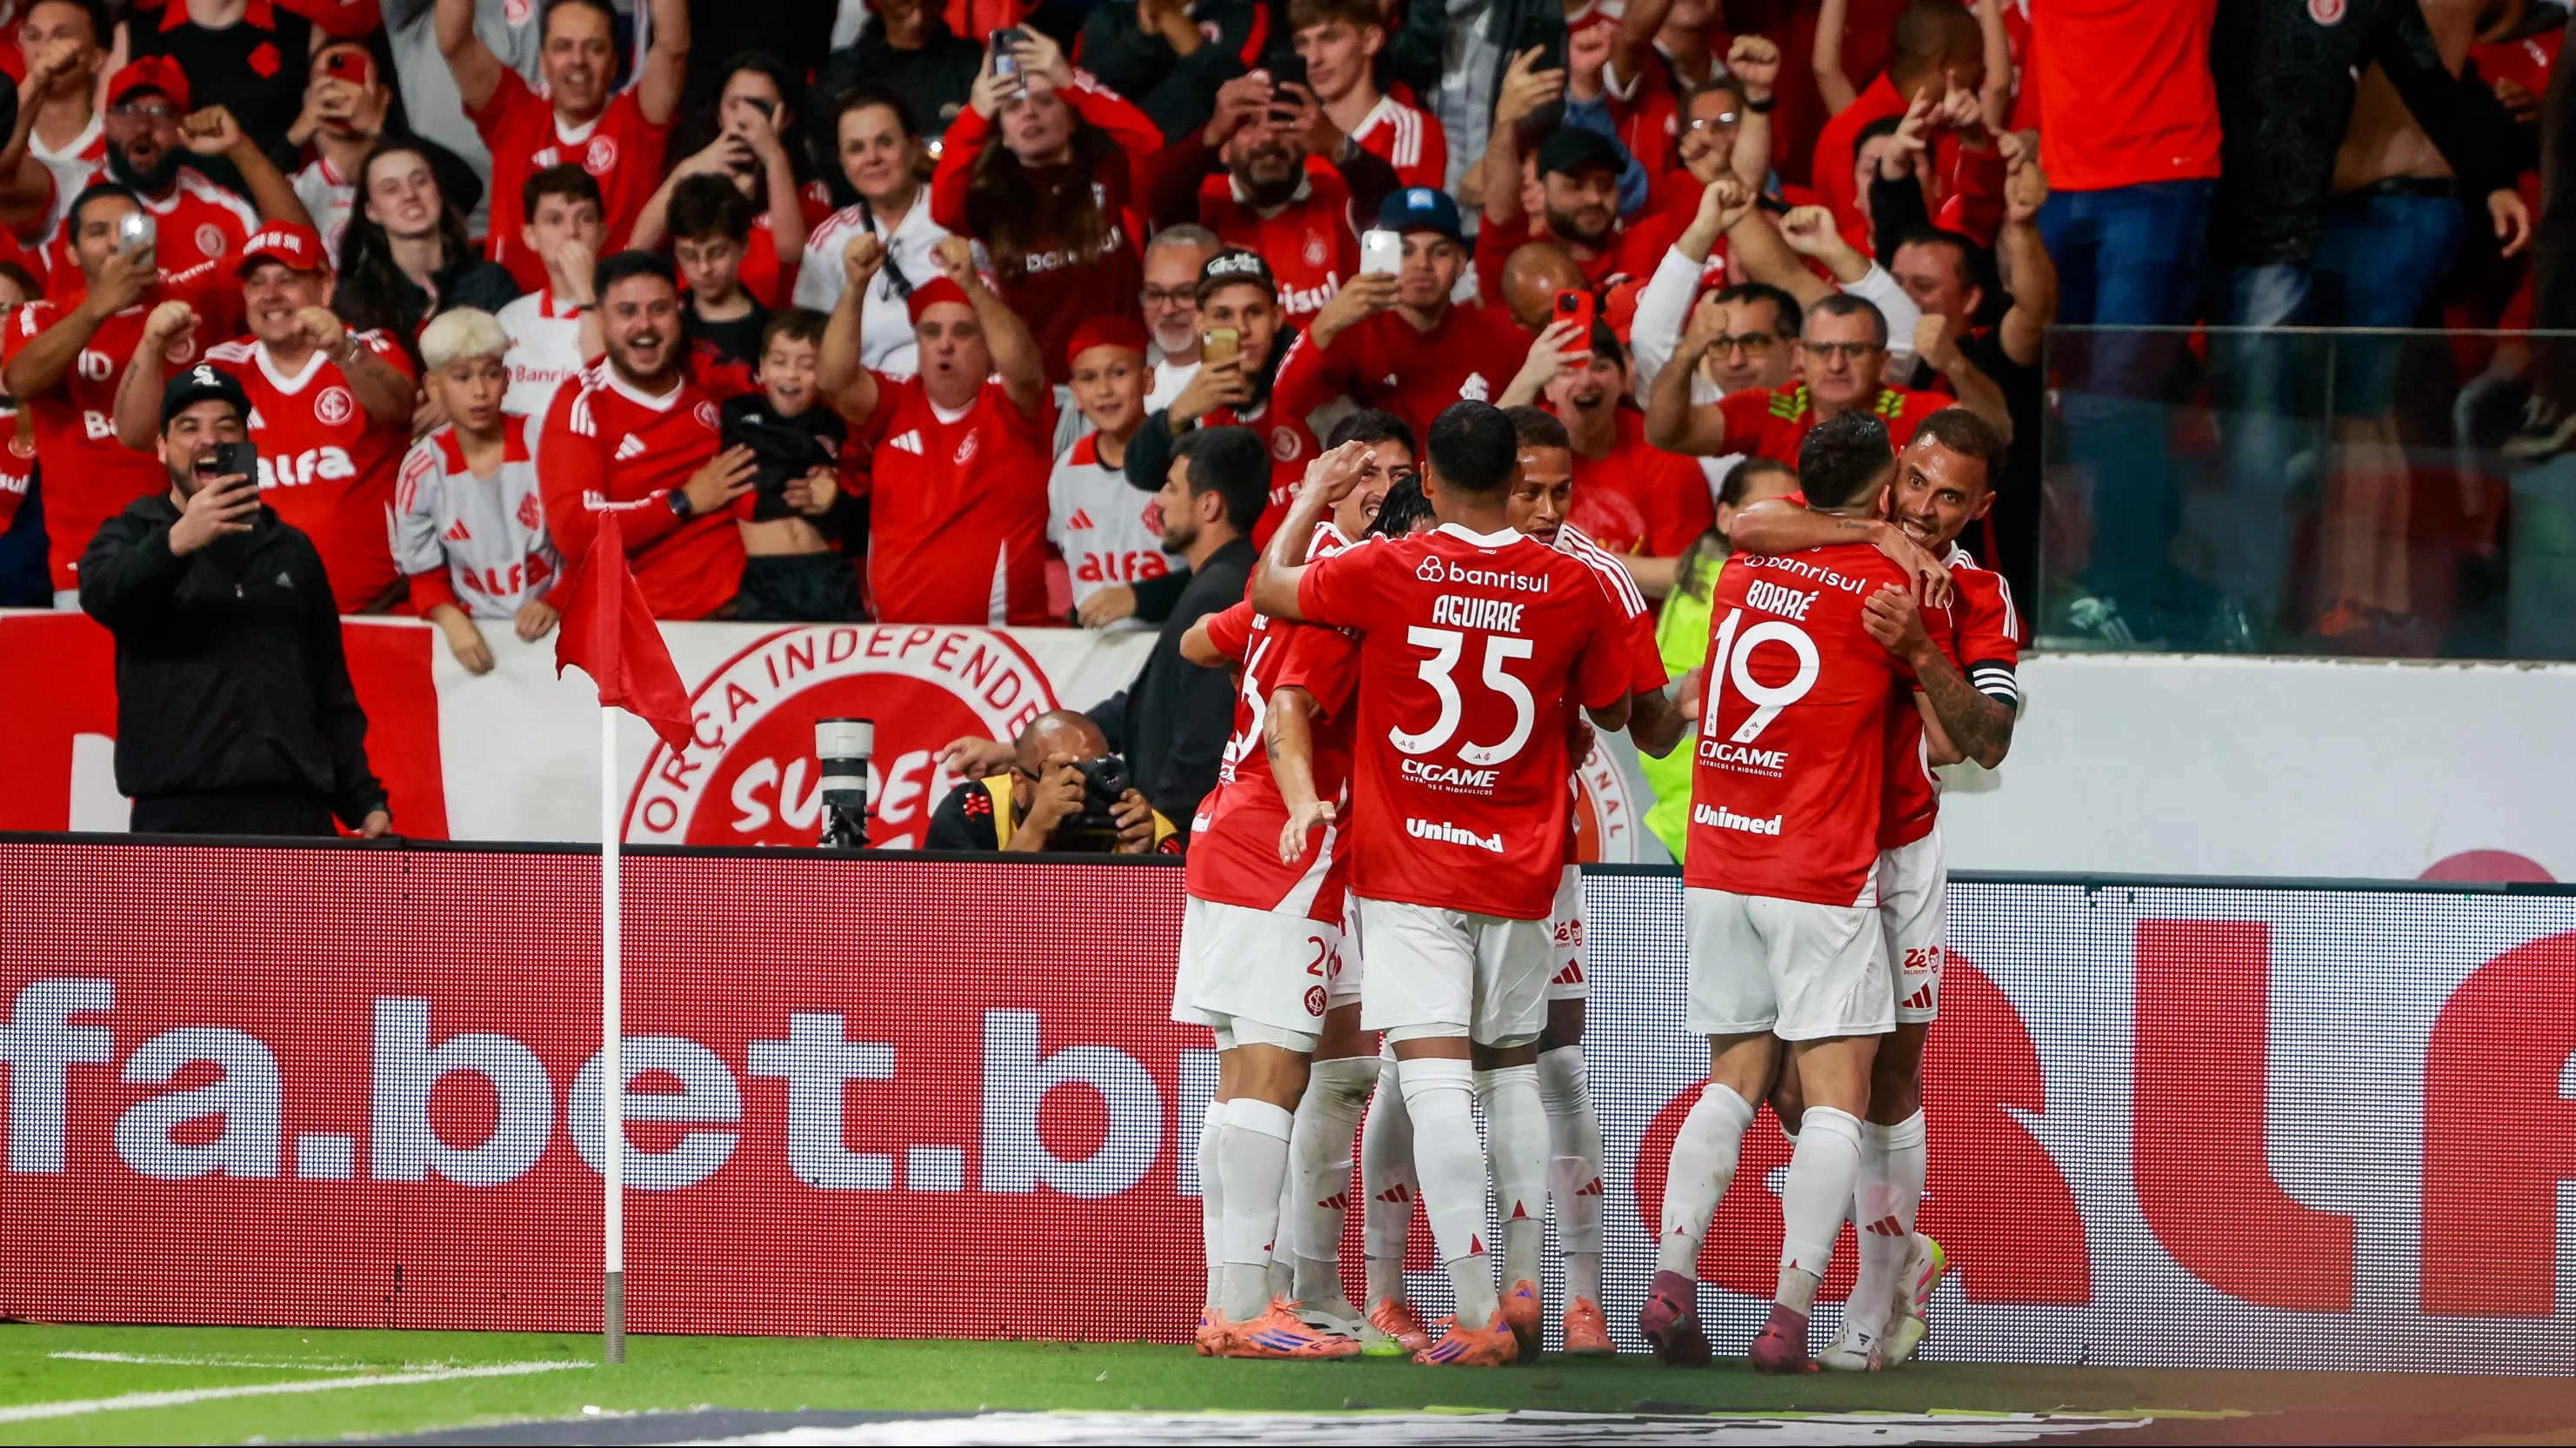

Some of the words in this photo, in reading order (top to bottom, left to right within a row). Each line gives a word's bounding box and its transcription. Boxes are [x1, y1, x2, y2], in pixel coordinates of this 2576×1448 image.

[517, 364, 577, 383] Banri
[1077, 550, 1170, 583] alfa
[1449, 561, 1548, 593] banrisul
[1765, 557, 1866, 595] banrisul
[1432, 594, 1525, 633] AGUIRRE
[1745, 579, 1819, 622] BORRÉ
[1703, 607, 1820, 744] 19
[1388, 624, 1535, 766] 35
[1698, 740, 1789, 770] CIGAME
[1401, 758, 1500, 787] CIGAME
[1694, 804, 1782, 836] Unimed
[1904, 948, 1927, 968] Zé
